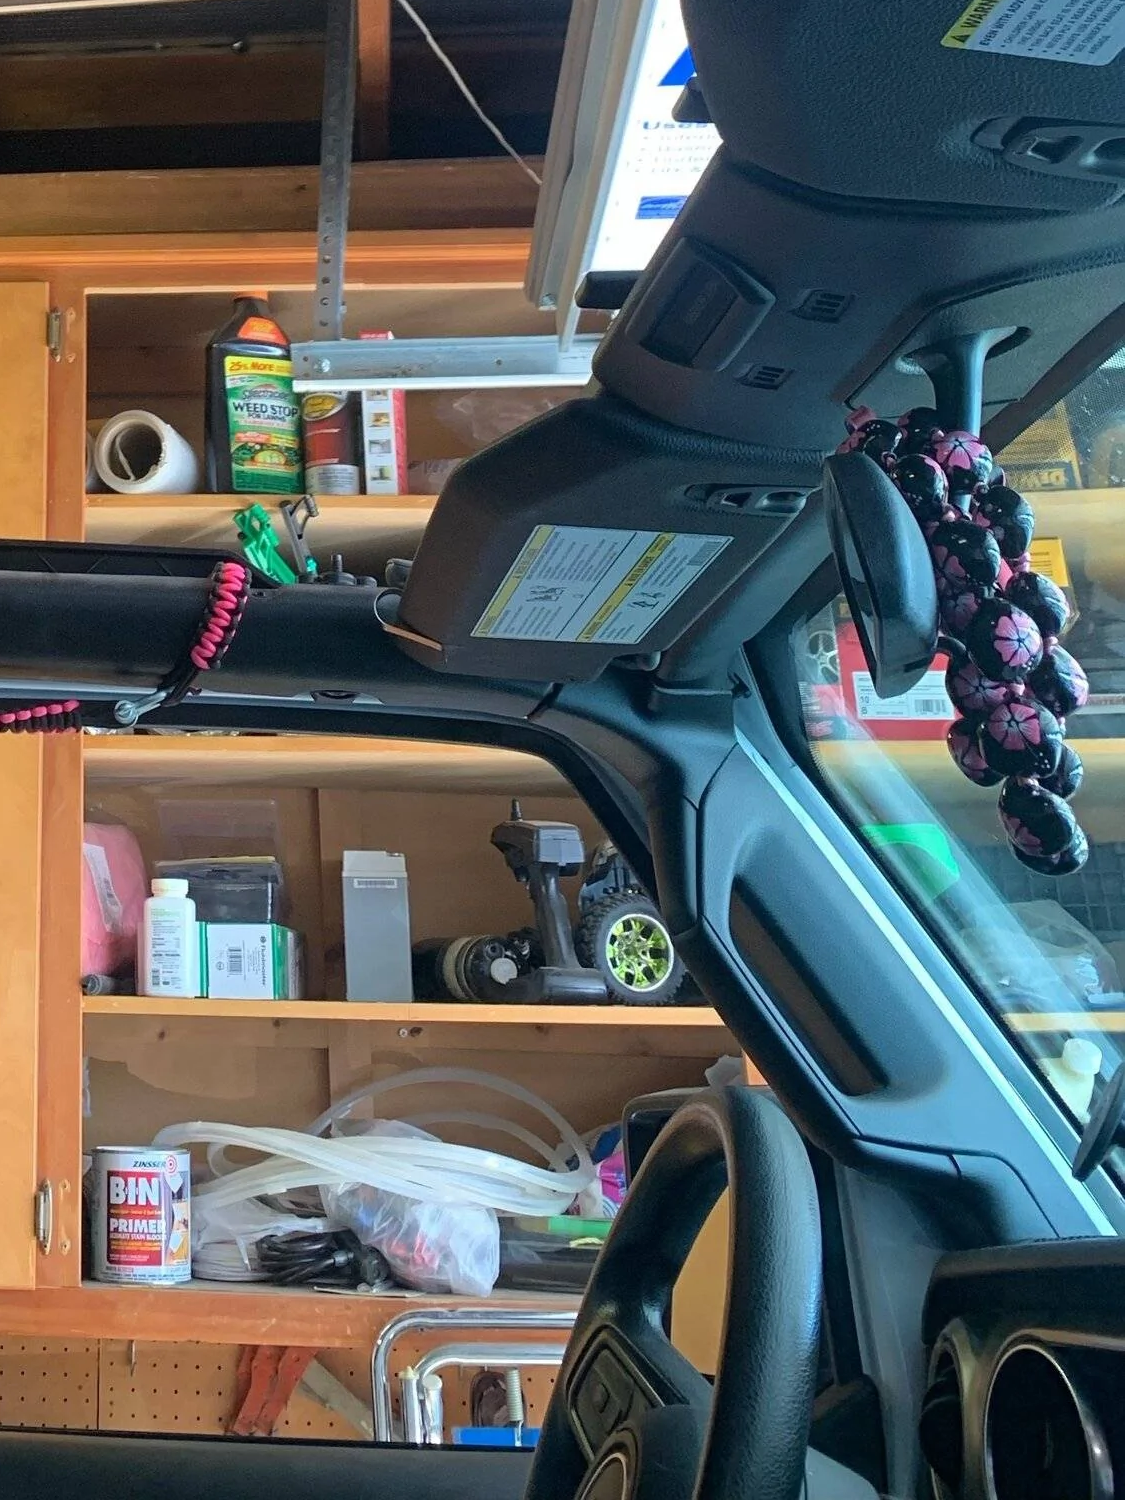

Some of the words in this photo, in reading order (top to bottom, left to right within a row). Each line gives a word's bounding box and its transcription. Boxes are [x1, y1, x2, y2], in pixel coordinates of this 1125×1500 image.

[979, 29, 999, 46] EVEN
[992, 13, 1013, 29] WITH
[232, 401, 268, 413] WEED
[269, 403, 299, 418] STOP
[132, 1160, 166, 1168] ZINSSER
[109, 1217, 167, 1234] PRIMER
